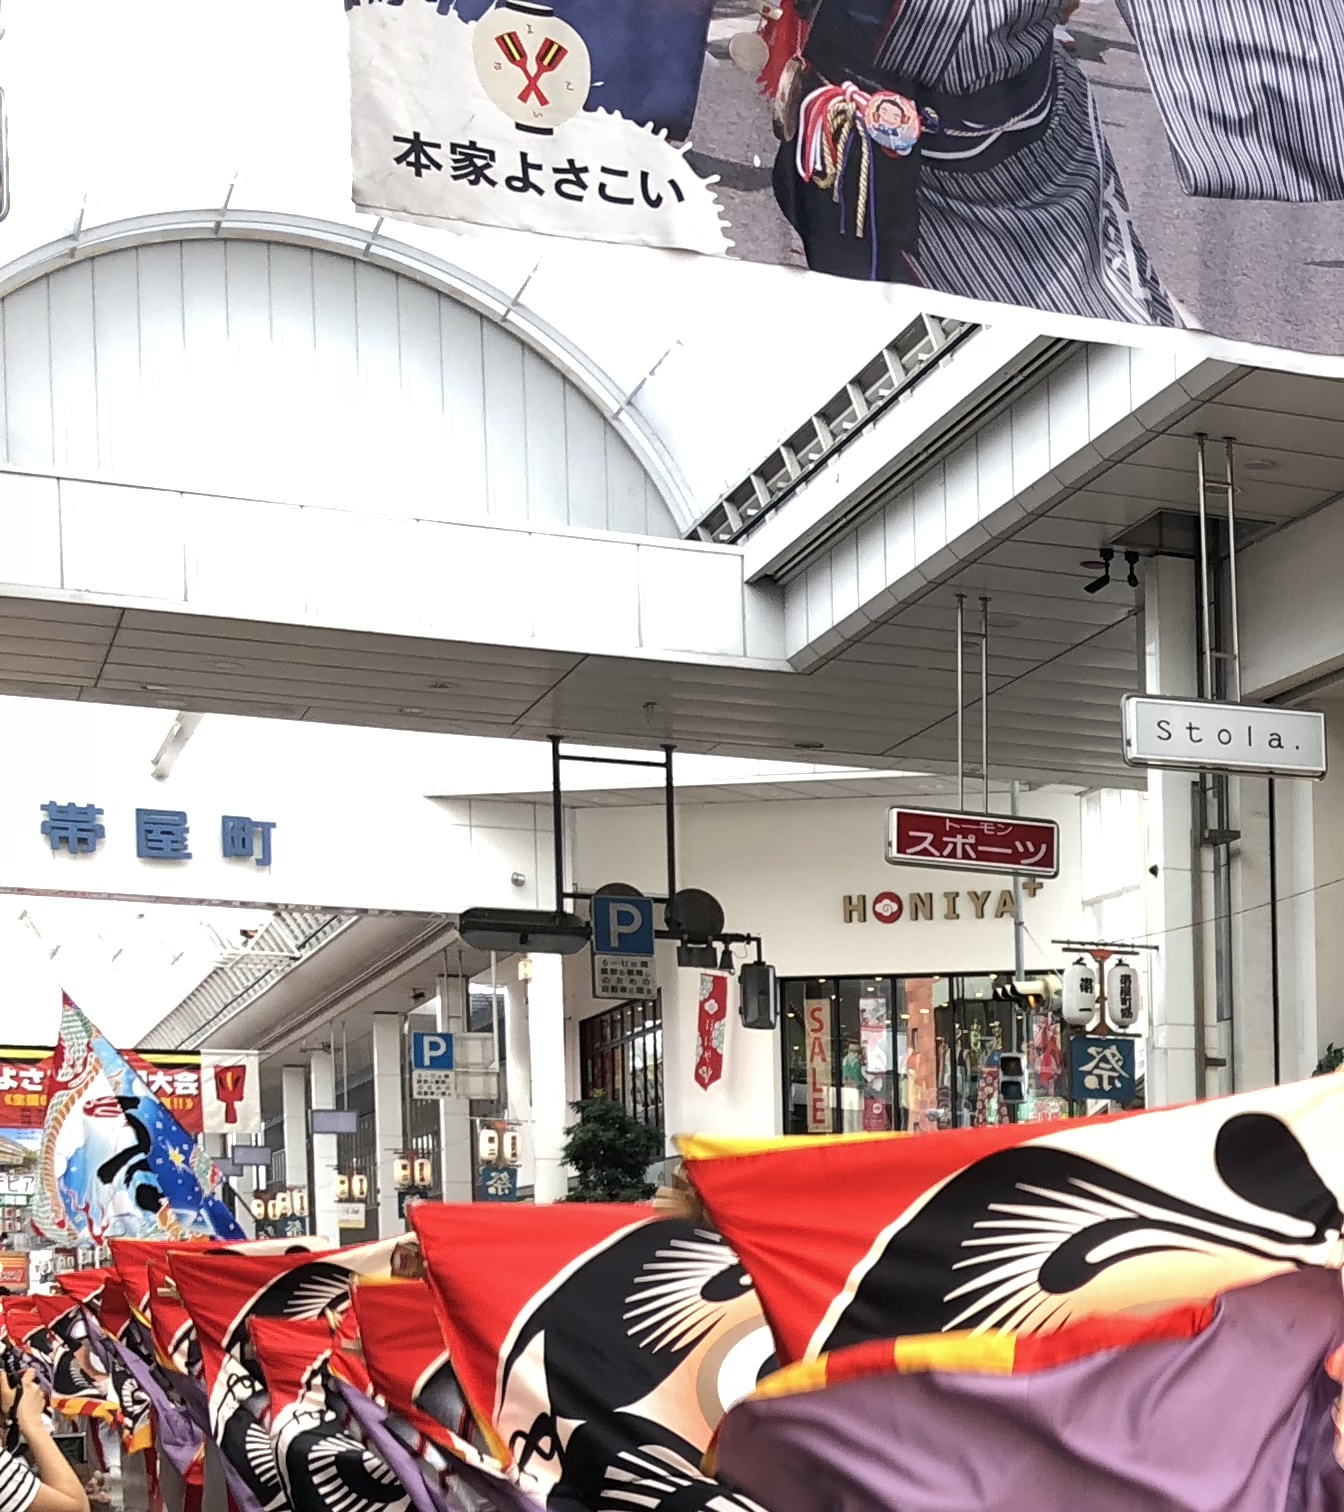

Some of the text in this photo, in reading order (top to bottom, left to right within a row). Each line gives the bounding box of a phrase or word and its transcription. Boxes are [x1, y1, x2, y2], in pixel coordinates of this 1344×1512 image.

[393, 131, 684, 208] 本家よさこい
[1157, 720, 1300, 750] Stola.
[40, 800, 276, 866] 帯屋町
[946, 819, 1013, 836] トーモン
[906, 831, 1047, 864] スポーツ
[609, 903, 642, 947] P
[422, 1036, 446, 1066] P
[810, 1006, 827, 1124] SALE
[0, 1066, 199, 1095] よさ 大会
